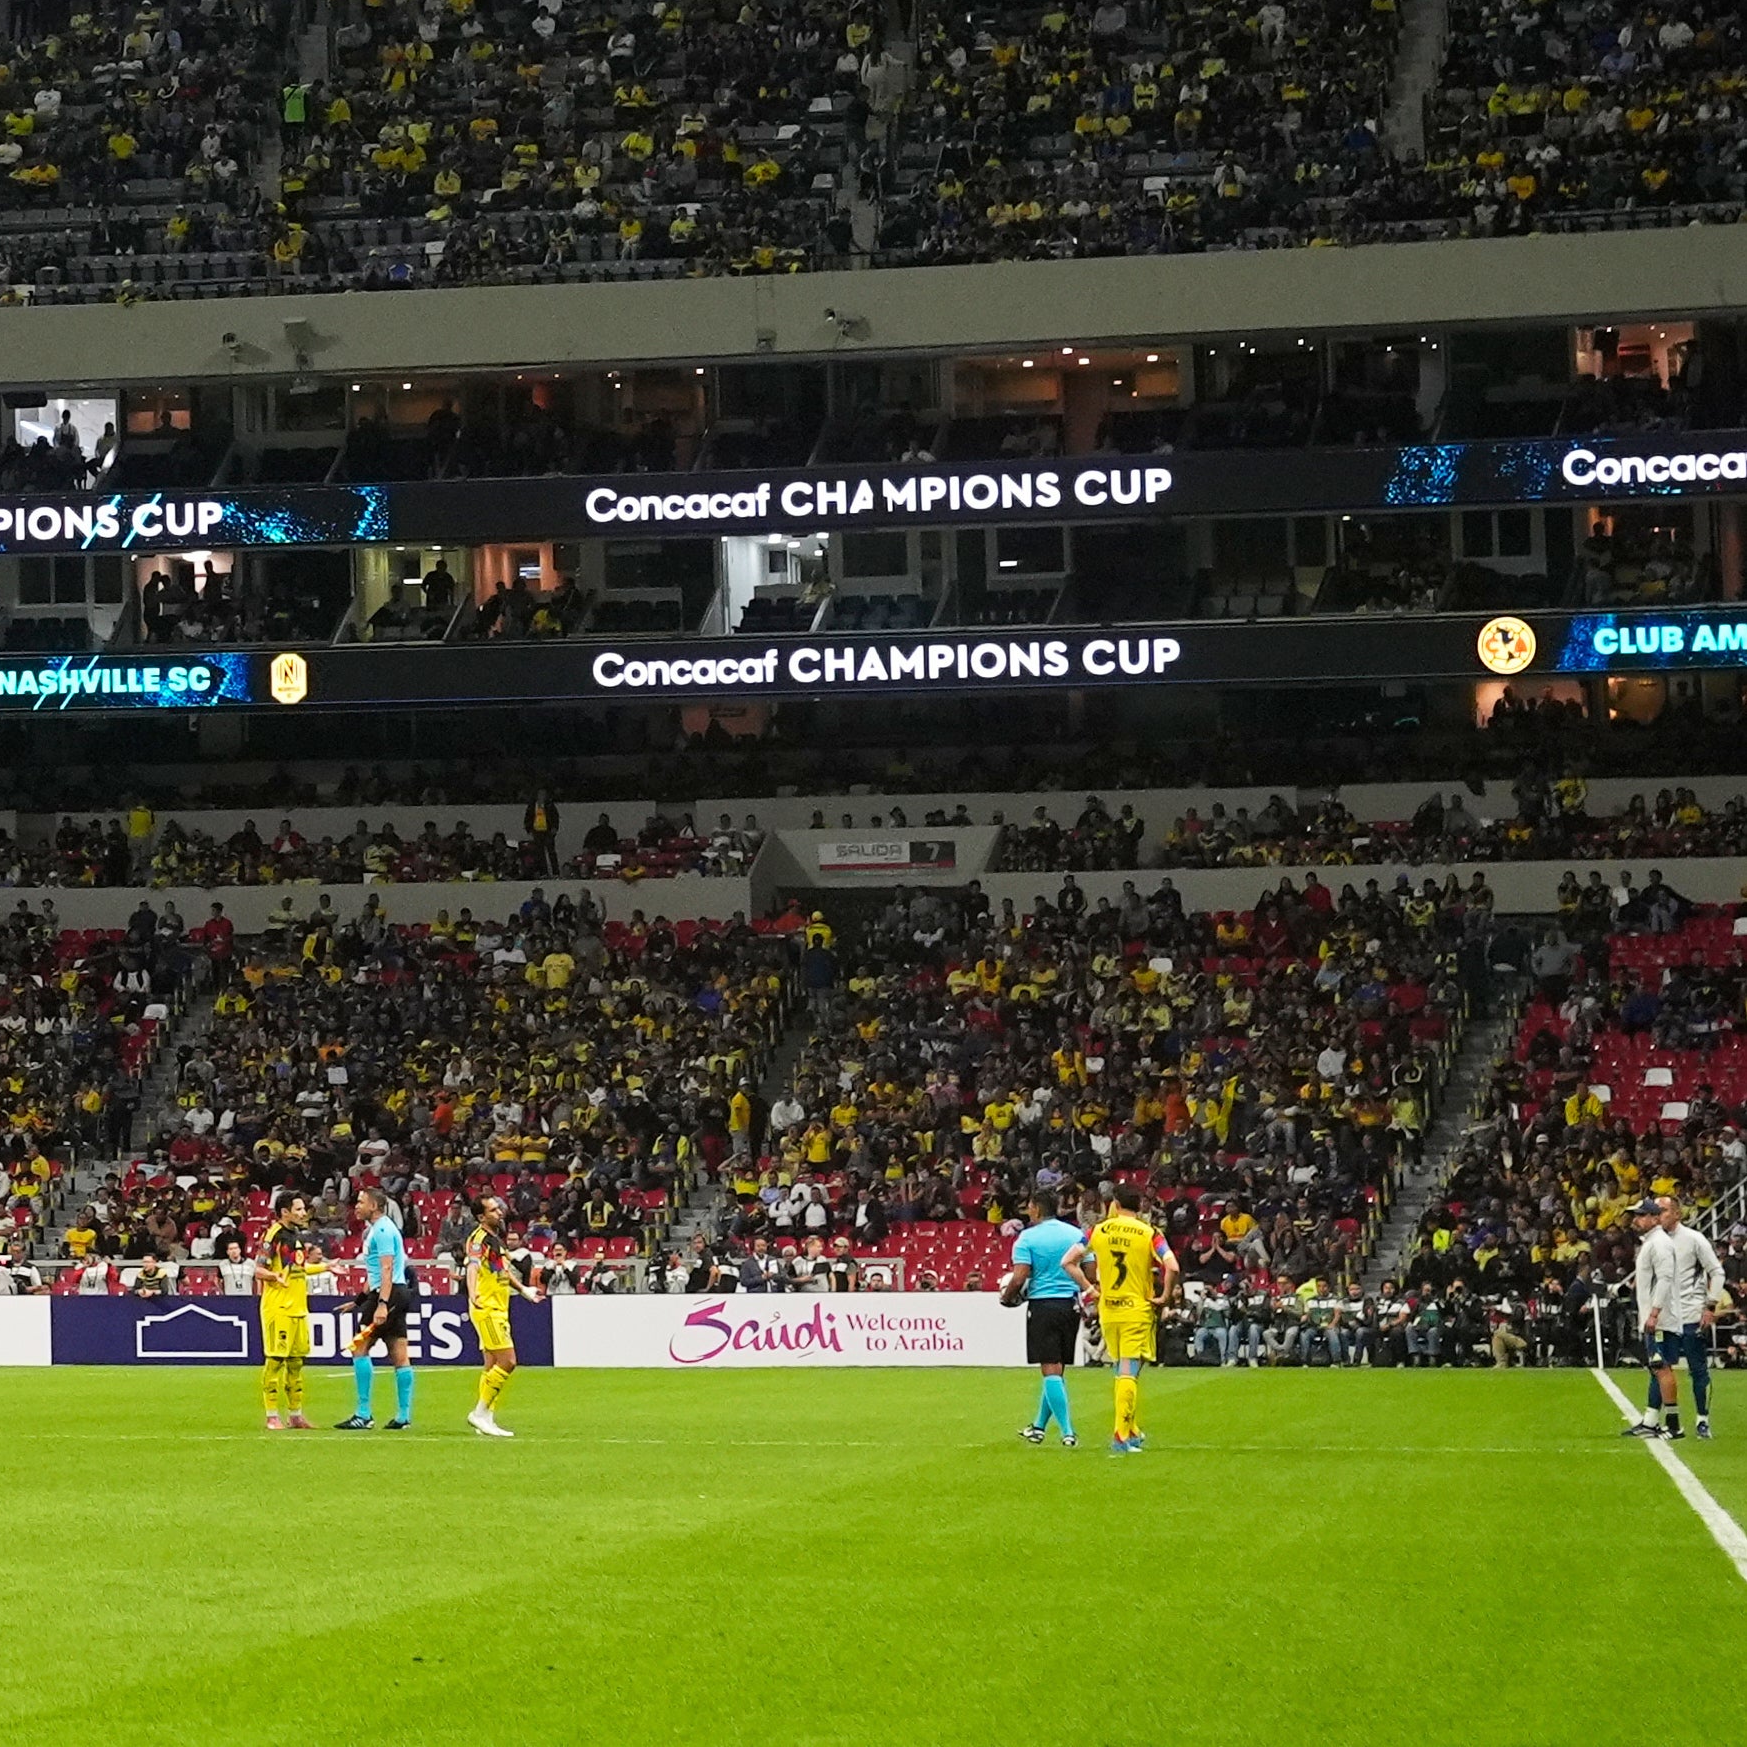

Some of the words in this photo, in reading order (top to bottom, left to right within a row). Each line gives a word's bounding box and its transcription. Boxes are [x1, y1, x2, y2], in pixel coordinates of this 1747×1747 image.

[1562, 448, 1747, 486] Concaca
[584, 482, 770, 524] Concacaf
[780, 472, 1062, 518] CHAMPIONS
[1072, 467, 1174, 507] CUP
[130, 501, 224, 538] CUP
[1592, 625, 1685, 655] CLUB
[167, 665, 212, 693] SC
[592, 648, 779, 688] Concacaf
[788, 642, 1068, 685] CHAMPIONS
[1081, 637, 1181, 677] CUP
[835, 843, 903, 859] SALIDA
[925, 842, 939, 861] 7
[1100, 1222, 1145, 1236] Corona
[1109, 1249, 1127, 1291] 3
[669, 1300, 844, 1364] Saudi
[846, 1313, 947, 1331] Welcome
[865, 1335, 887, 1351] to
[894, 1332, 964, 1351] Arabia
